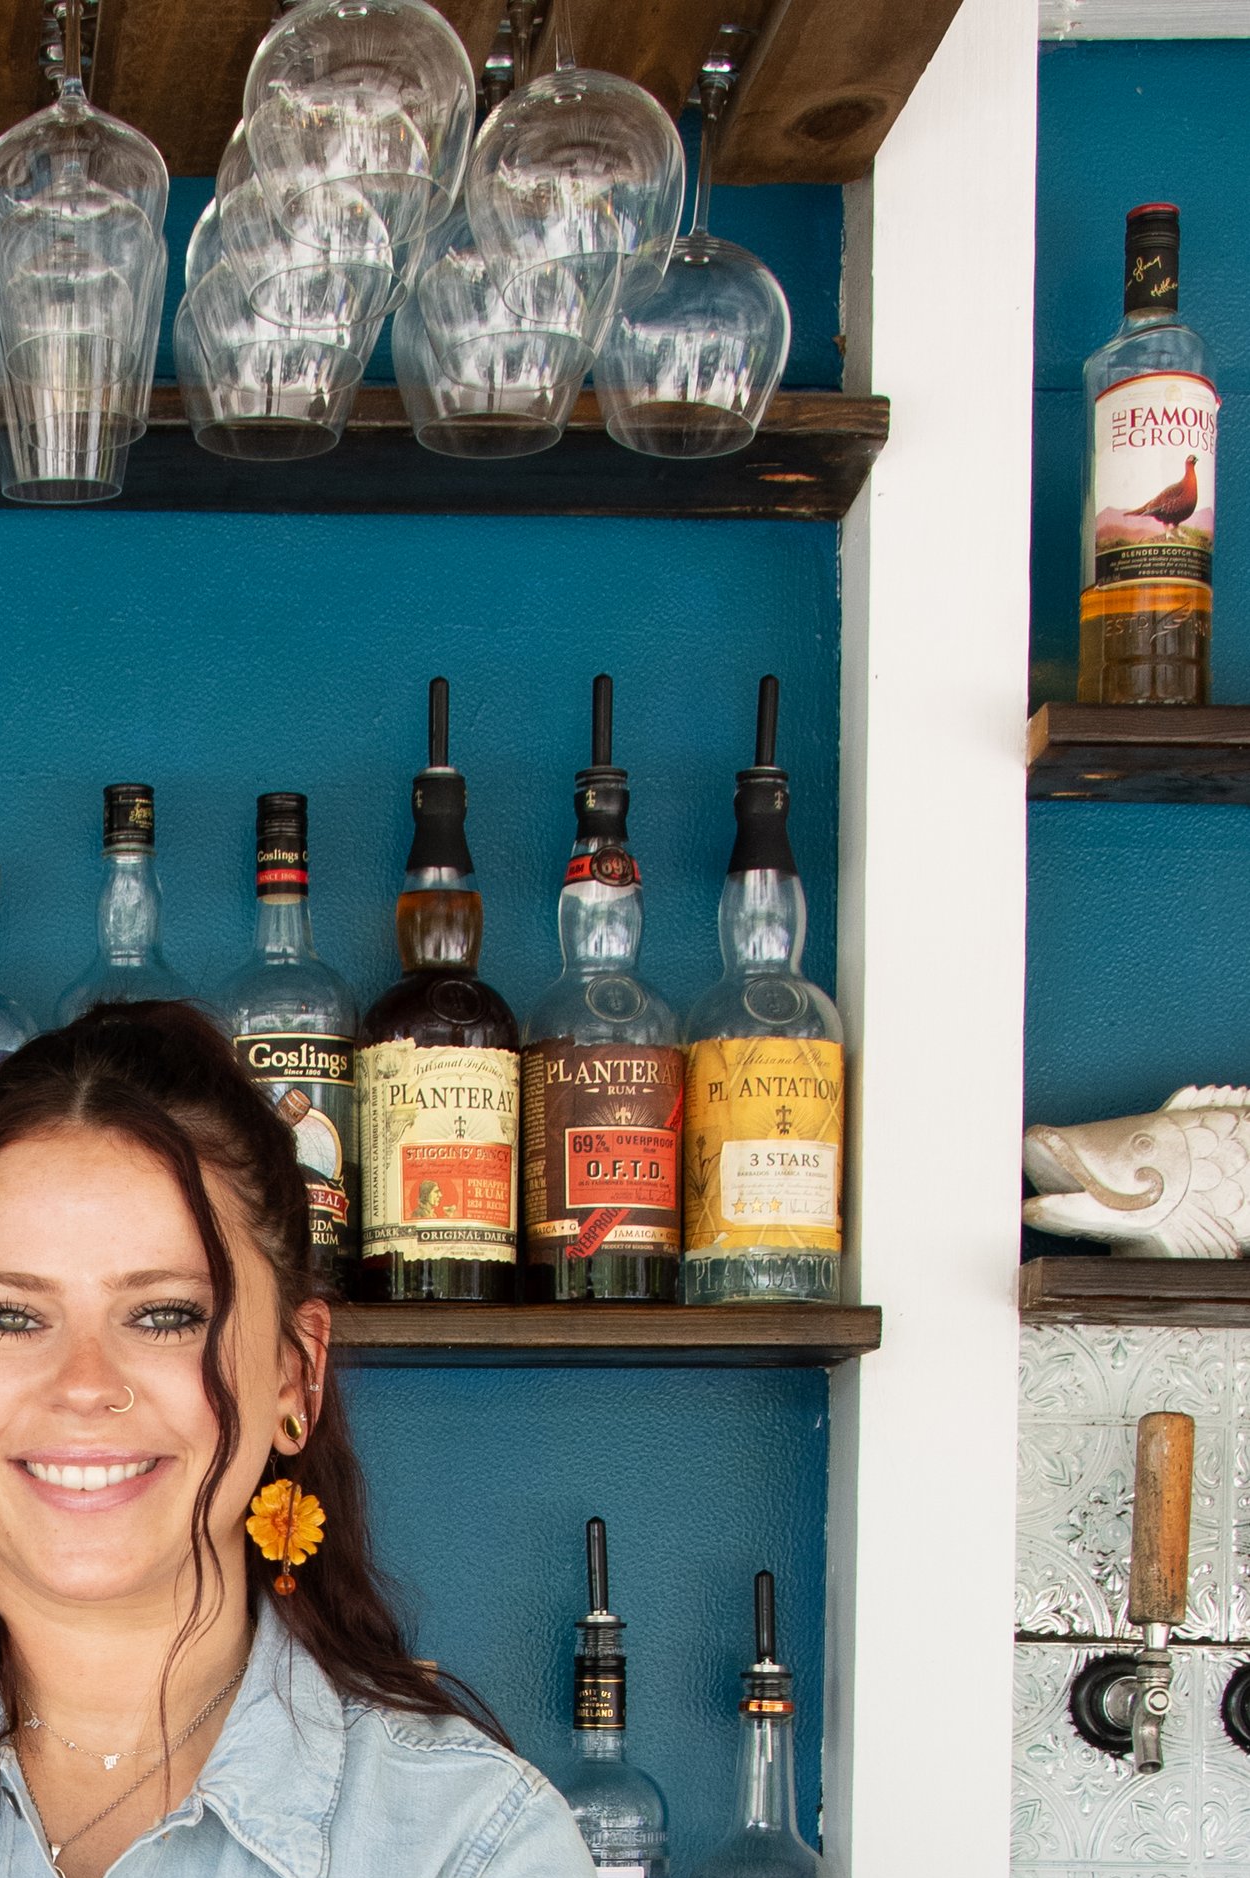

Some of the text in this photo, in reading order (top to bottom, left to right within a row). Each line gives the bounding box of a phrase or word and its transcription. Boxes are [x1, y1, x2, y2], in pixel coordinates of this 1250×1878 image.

[1129, 406, 1215, 436] FAMOUS
[1112, 410, 1127, 453] THE
[1128, 428, 1215, 455] GROUSE
[1121, 548, 1191, 558] BLENDED SCOTCH
[258, 848, 299, 863] Goslings
[248, 1043, 348, 1078] Goslings
[735, 1048, 799, 1065] Artisanal
[413, 1057, 504, 1080] Artisanal Infusion
[545, 1058, 680, 1086] PLANTERAY
[607, 1085, 636, 1095] RUM
[708, 1077, 840, 1103] PLANTATION
[389, 1083, 515, 1113] PLANTERAY
[616, 1135, 675, 1149] OVERPROOF
[406, 1147, 509, 1162] STIGGINS' FANCY
[750, 1153, 820, 1168] 3 STARS
[586, 1160, 666, 1180] O.F.T.D.
[372, 1164, 380, 1217] ARTISANAL
[467, 1179, 508, 1189] PINEAPPLE
[474, 1187, 504, 1200] RUM
[312, 1232, 339, 1246] RUM
[375, 1228, 399, 1238] DARK
[421, 1231, 507, 1242] ORIGINAL DARK
[569, 1208, 619, 1257] OVERPROO
[613, 1229, 657, 1239] JAMAICA
[601, 1690, 612, 1699] US
